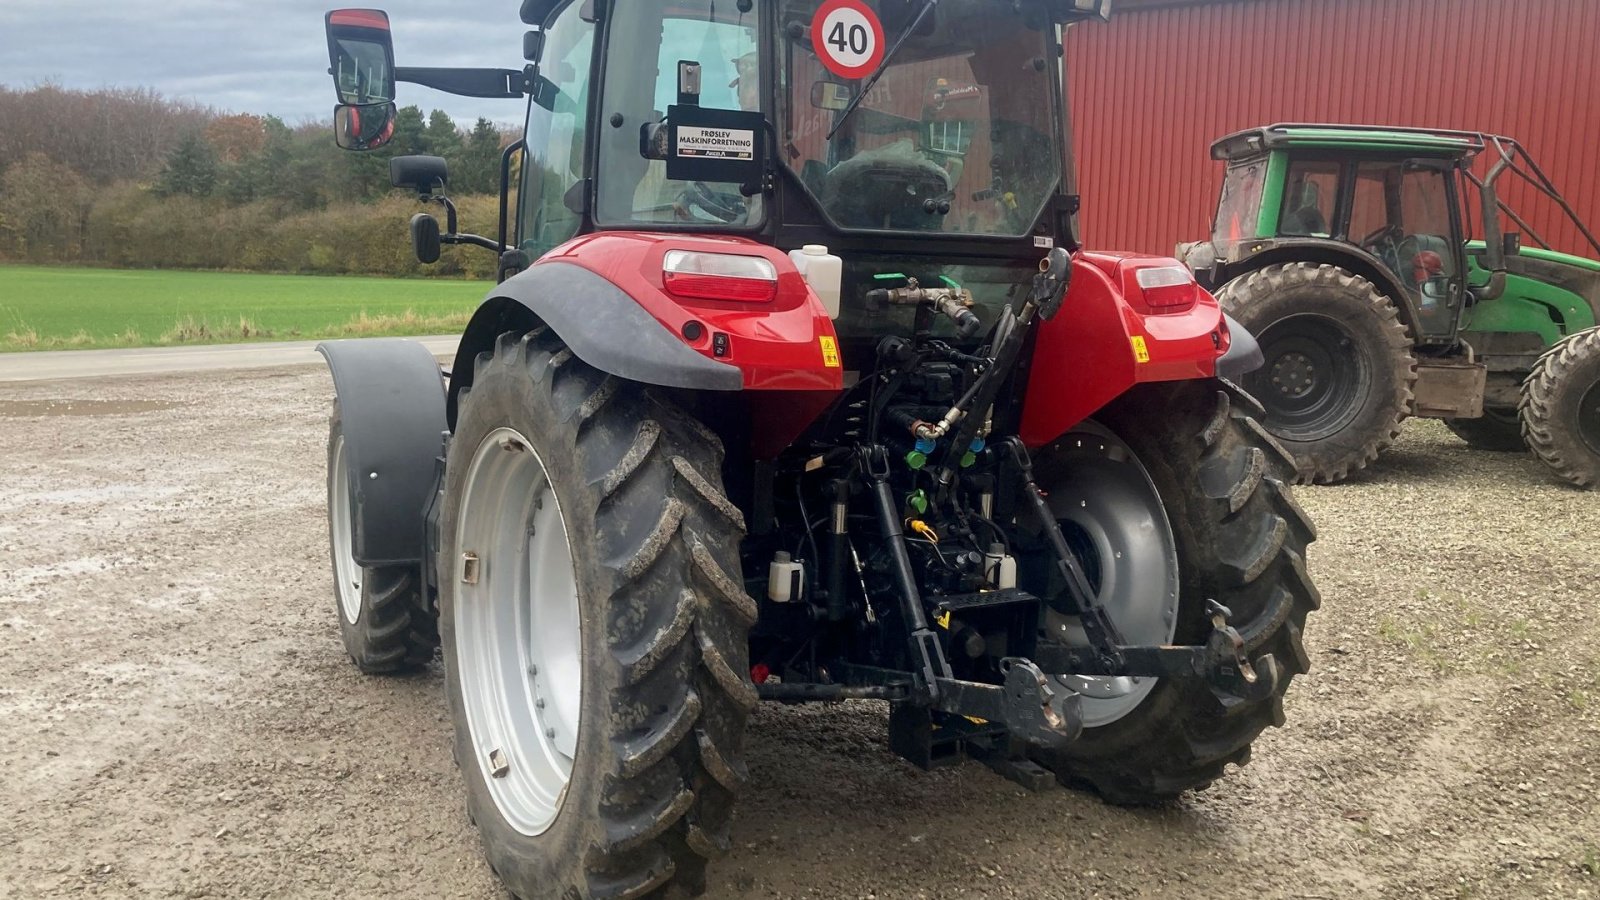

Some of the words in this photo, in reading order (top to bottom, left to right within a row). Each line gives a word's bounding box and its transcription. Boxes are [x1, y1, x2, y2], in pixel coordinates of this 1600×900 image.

[828, 22, 867, 55] 40
[701, 130, 731, 138] FRØSLEV
[679, 136, 751, 147] MASKINFORRETNING
